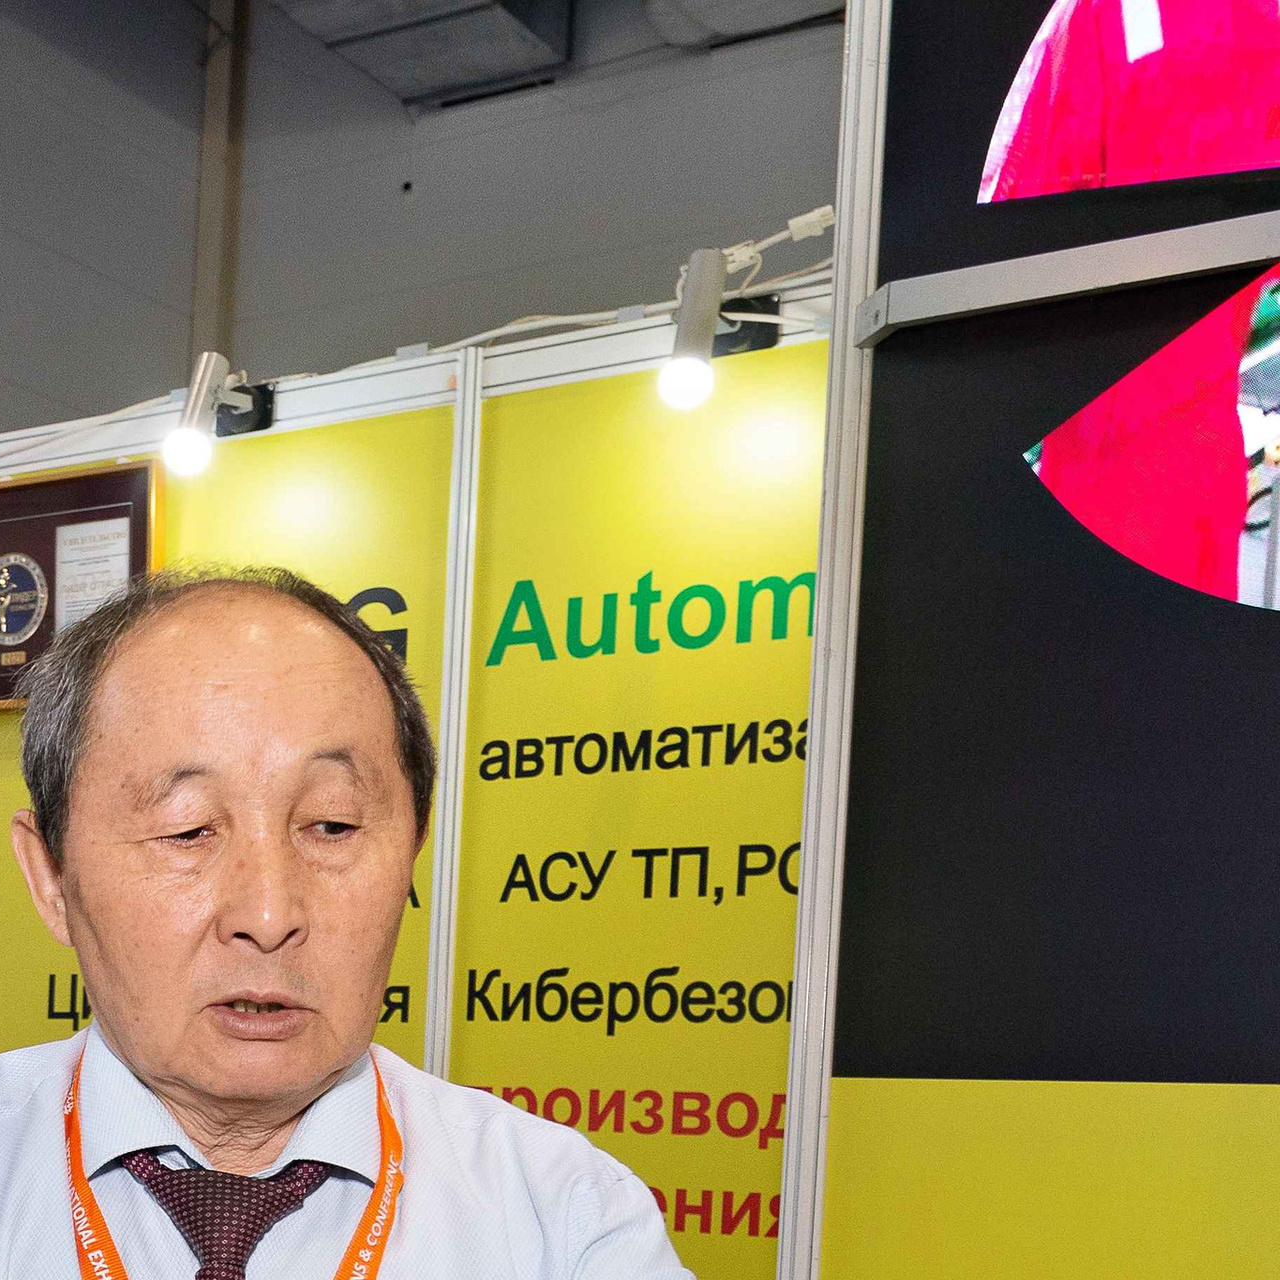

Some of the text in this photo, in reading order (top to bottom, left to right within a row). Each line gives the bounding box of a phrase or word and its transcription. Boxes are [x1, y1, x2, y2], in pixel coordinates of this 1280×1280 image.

[499, 850, 617, 902] АСУ
[465, 965, 794, 1037] Кибербезо
[470, 1086, 787, 1150] роизвод
[358, 1248, 373, 1262] &
